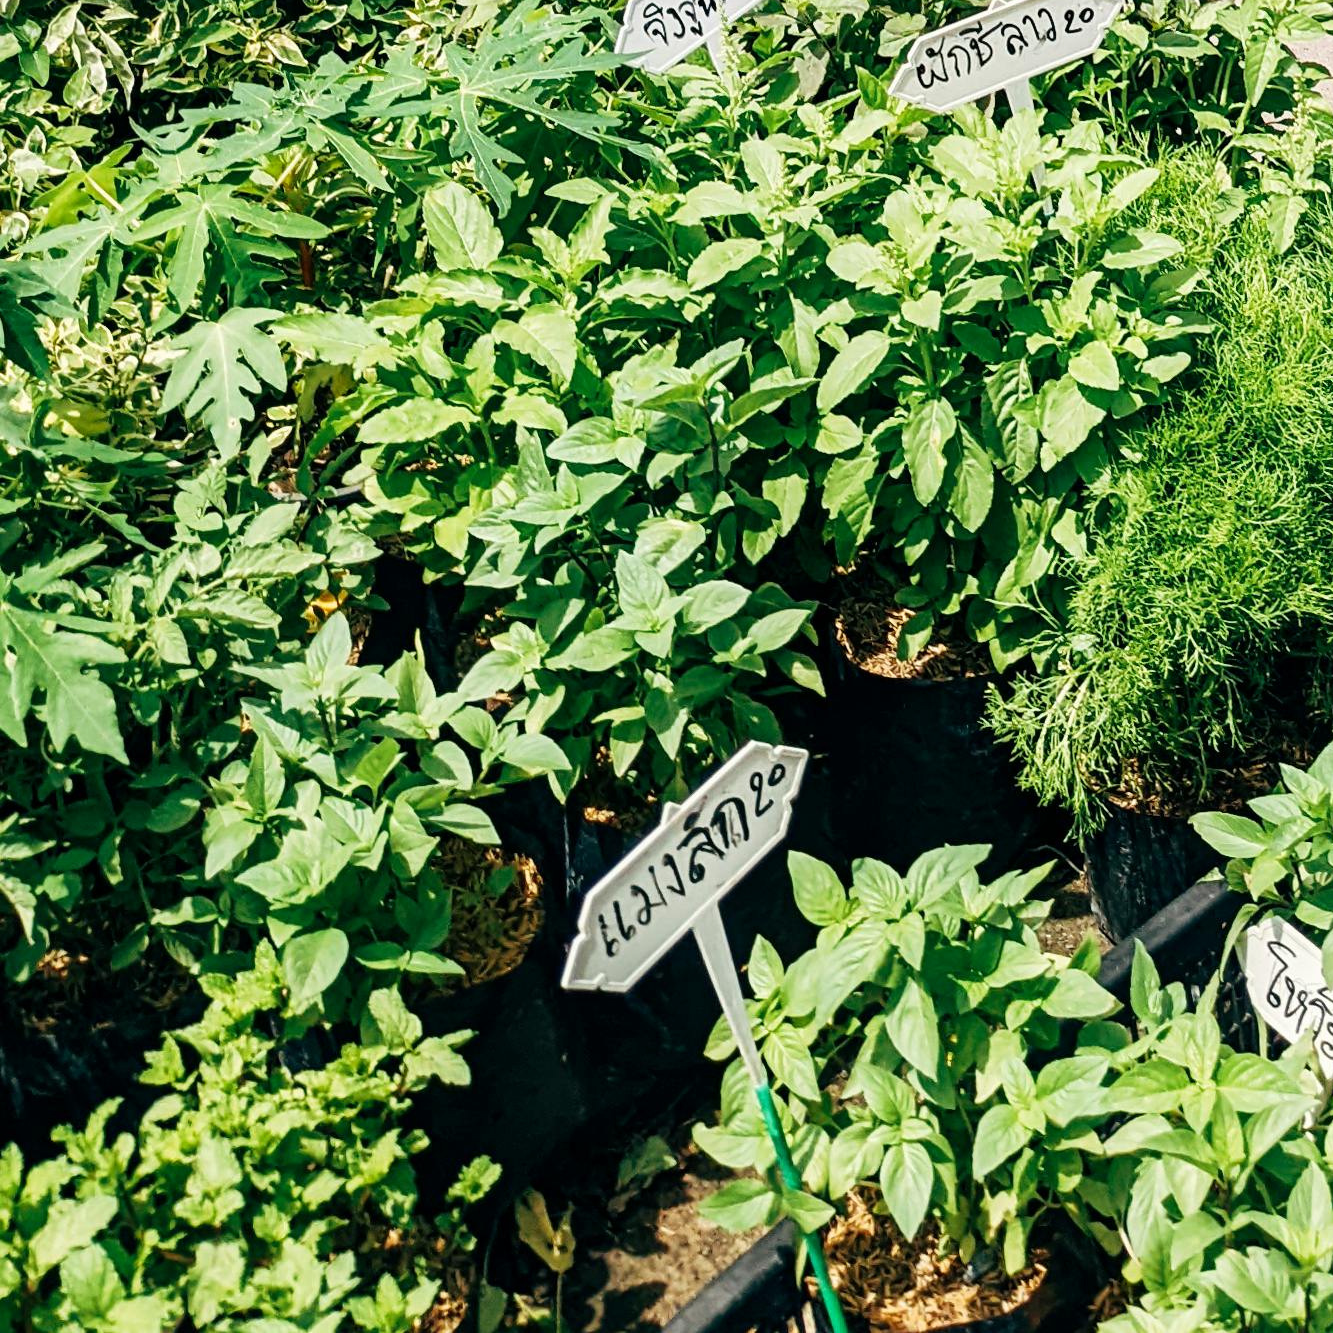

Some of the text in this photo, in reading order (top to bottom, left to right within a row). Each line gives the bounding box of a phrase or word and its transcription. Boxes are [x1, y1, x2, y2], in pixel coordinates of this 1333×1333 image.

[916, 7, 1095, 89] ผักชีลาว 20
[750, 763, 786, 818] 20
